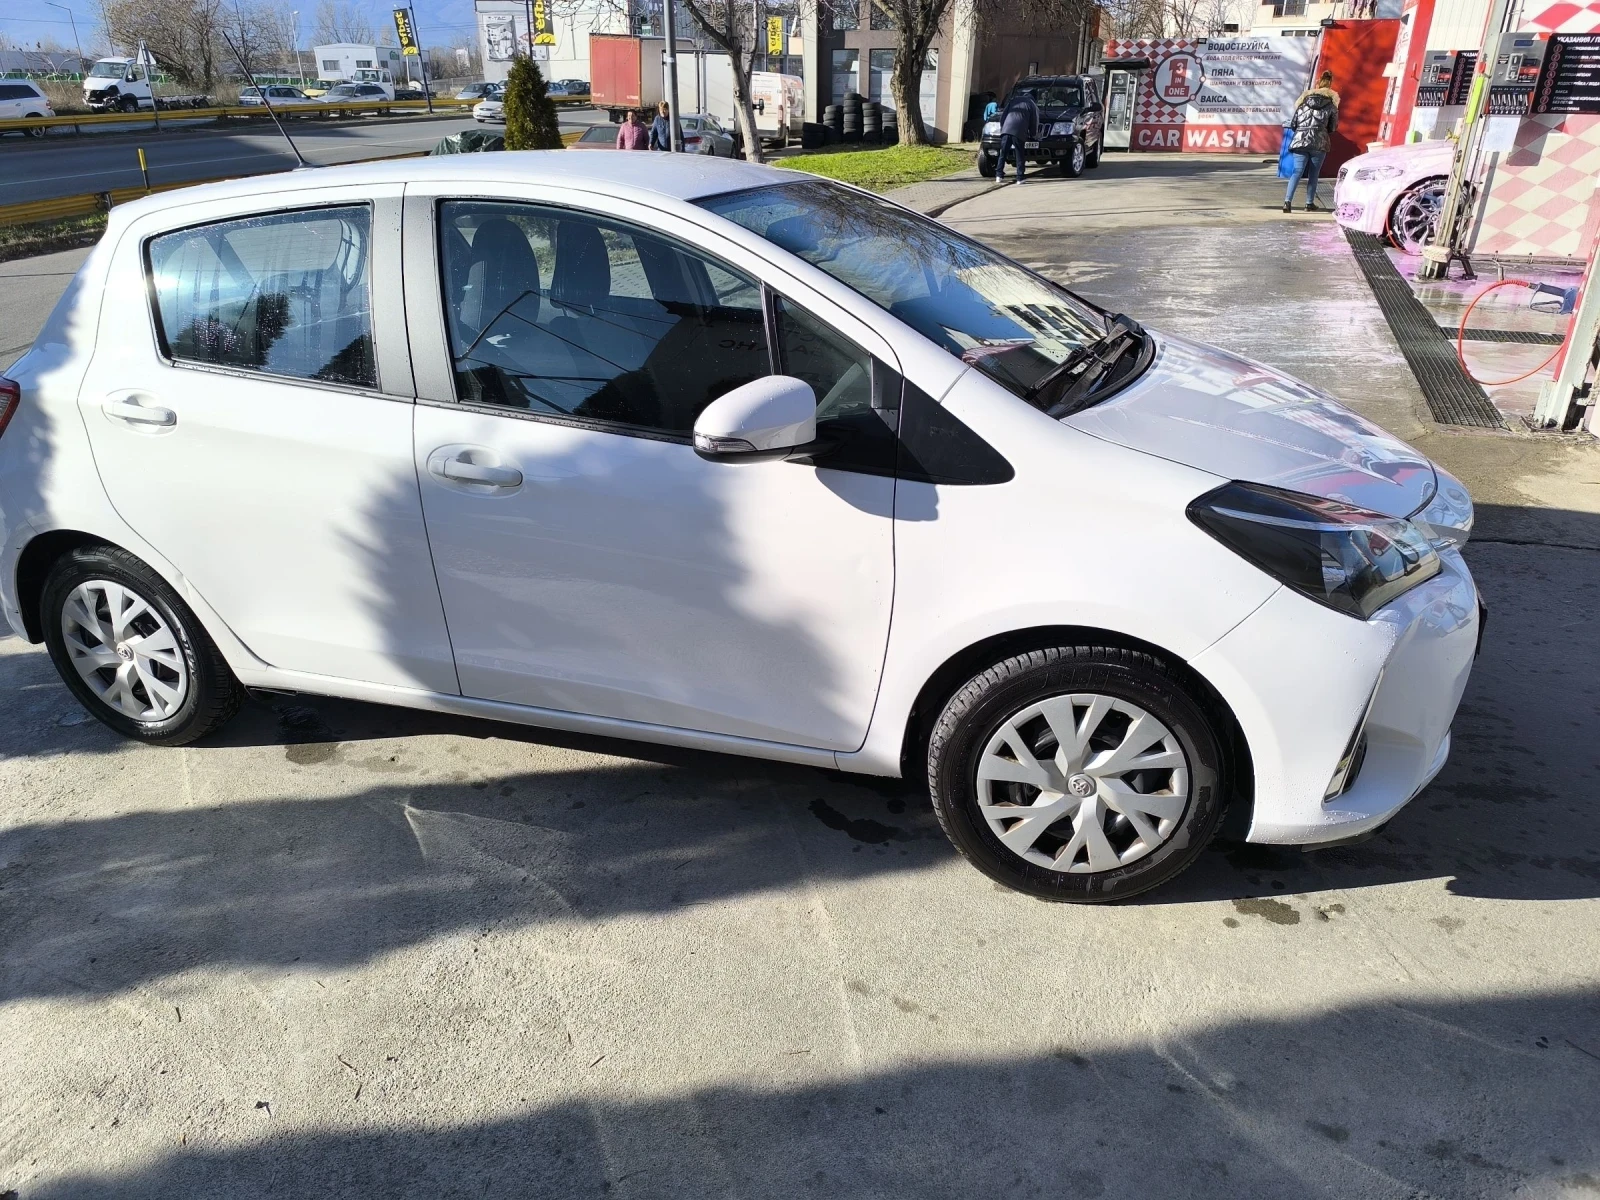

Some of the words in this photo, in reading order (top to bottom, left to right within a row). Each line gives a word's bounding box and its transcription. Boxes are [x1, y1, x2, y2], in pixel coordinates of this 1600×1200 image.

[1208, 40, 1270, 52] ВОДОСТРУЙКА
[1176, 62, 1184, 74] 3
[1200, 95, 1228, 103] ВАКСА
[1138, 129, 1180, 147] CAR
[1187, 129, 1251, 148] WASH
